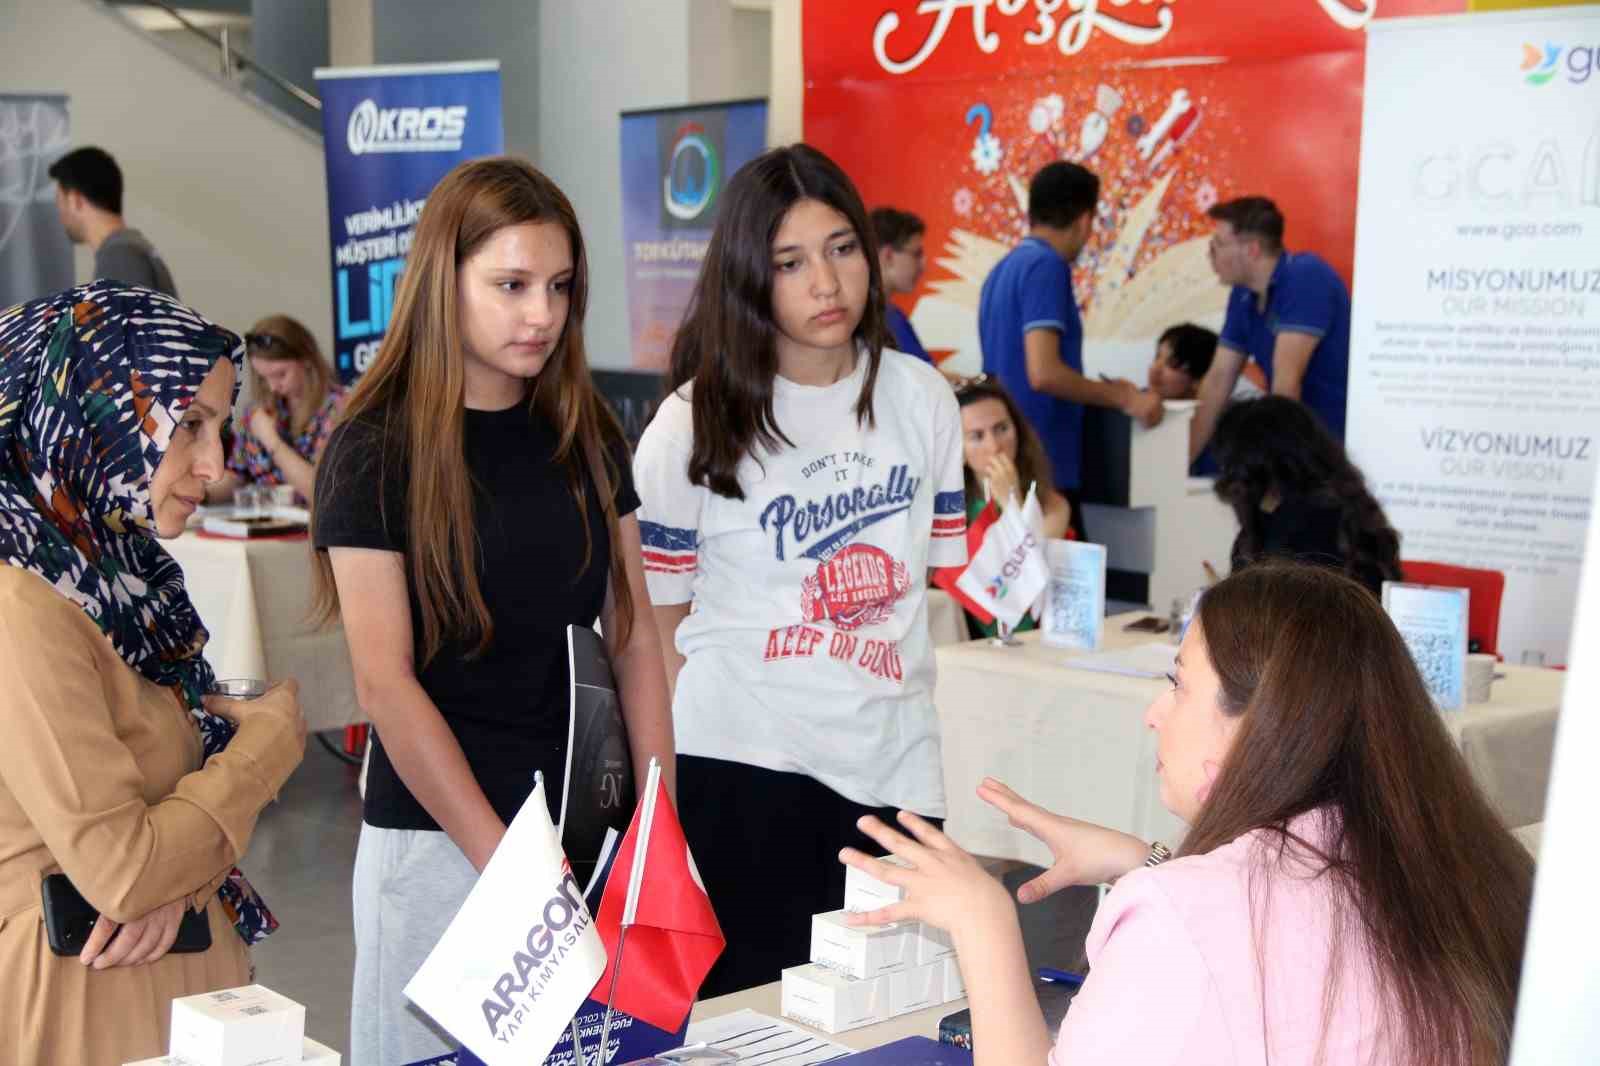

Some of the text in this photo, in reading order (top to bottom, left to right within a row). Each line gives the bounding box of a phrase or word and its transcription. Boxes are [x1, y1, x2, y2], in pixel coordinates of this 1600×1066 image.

[376, 105, 468, 140] KROS
[835, 469, 849, 482] IT
[845, 452, 876, 468] TAKE
[759, 464, 921, 561] Personally
[824, 552, 888, 592] LEGENDS
[829, 632, 859, 662] ON
